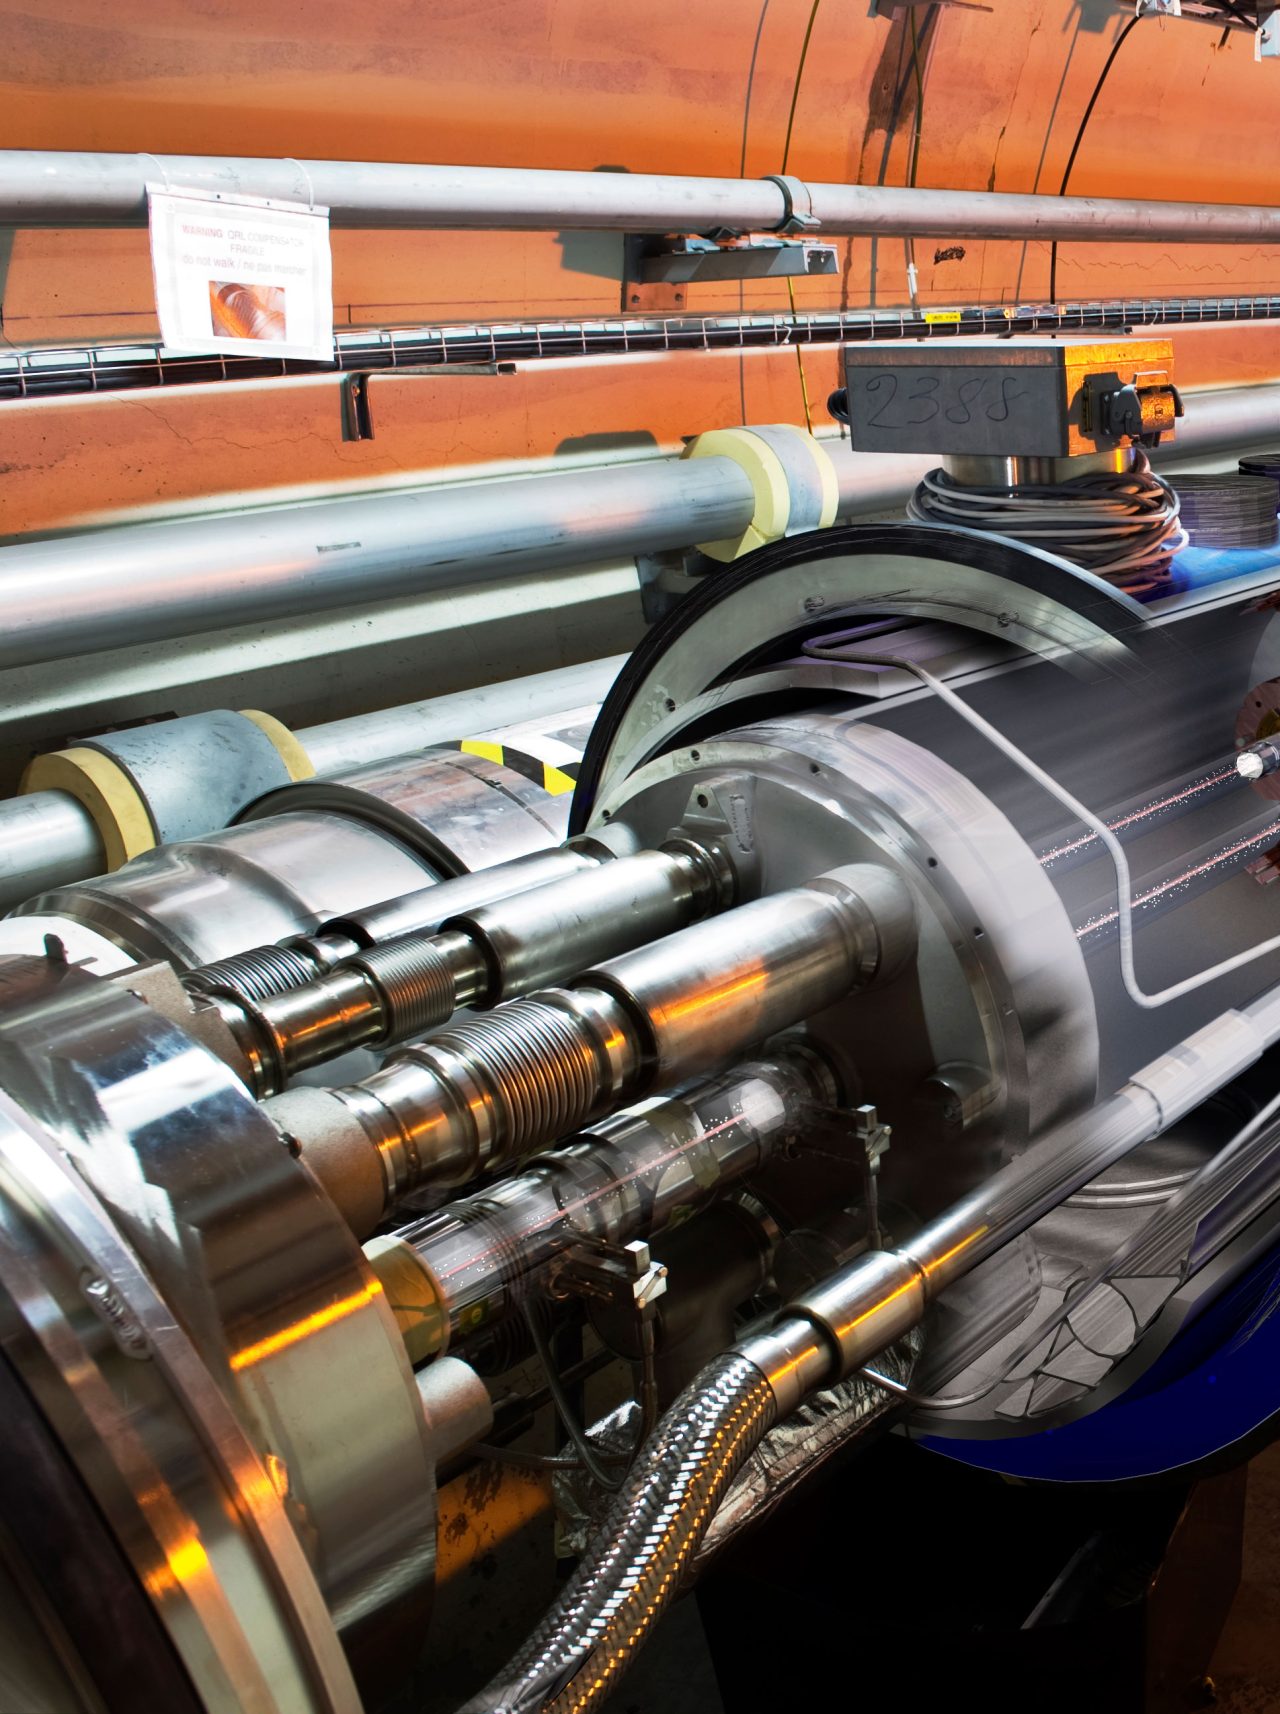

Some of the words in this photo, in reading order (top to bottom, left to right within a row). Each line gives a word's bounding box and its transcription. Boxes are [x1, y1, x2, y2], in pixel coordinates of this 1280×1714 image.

[183, 253, 194, 265] do
[196, 255, 211, 267] not
[213, 255, 235, 270] walk
[866, 373, 1029, 429] 2388
